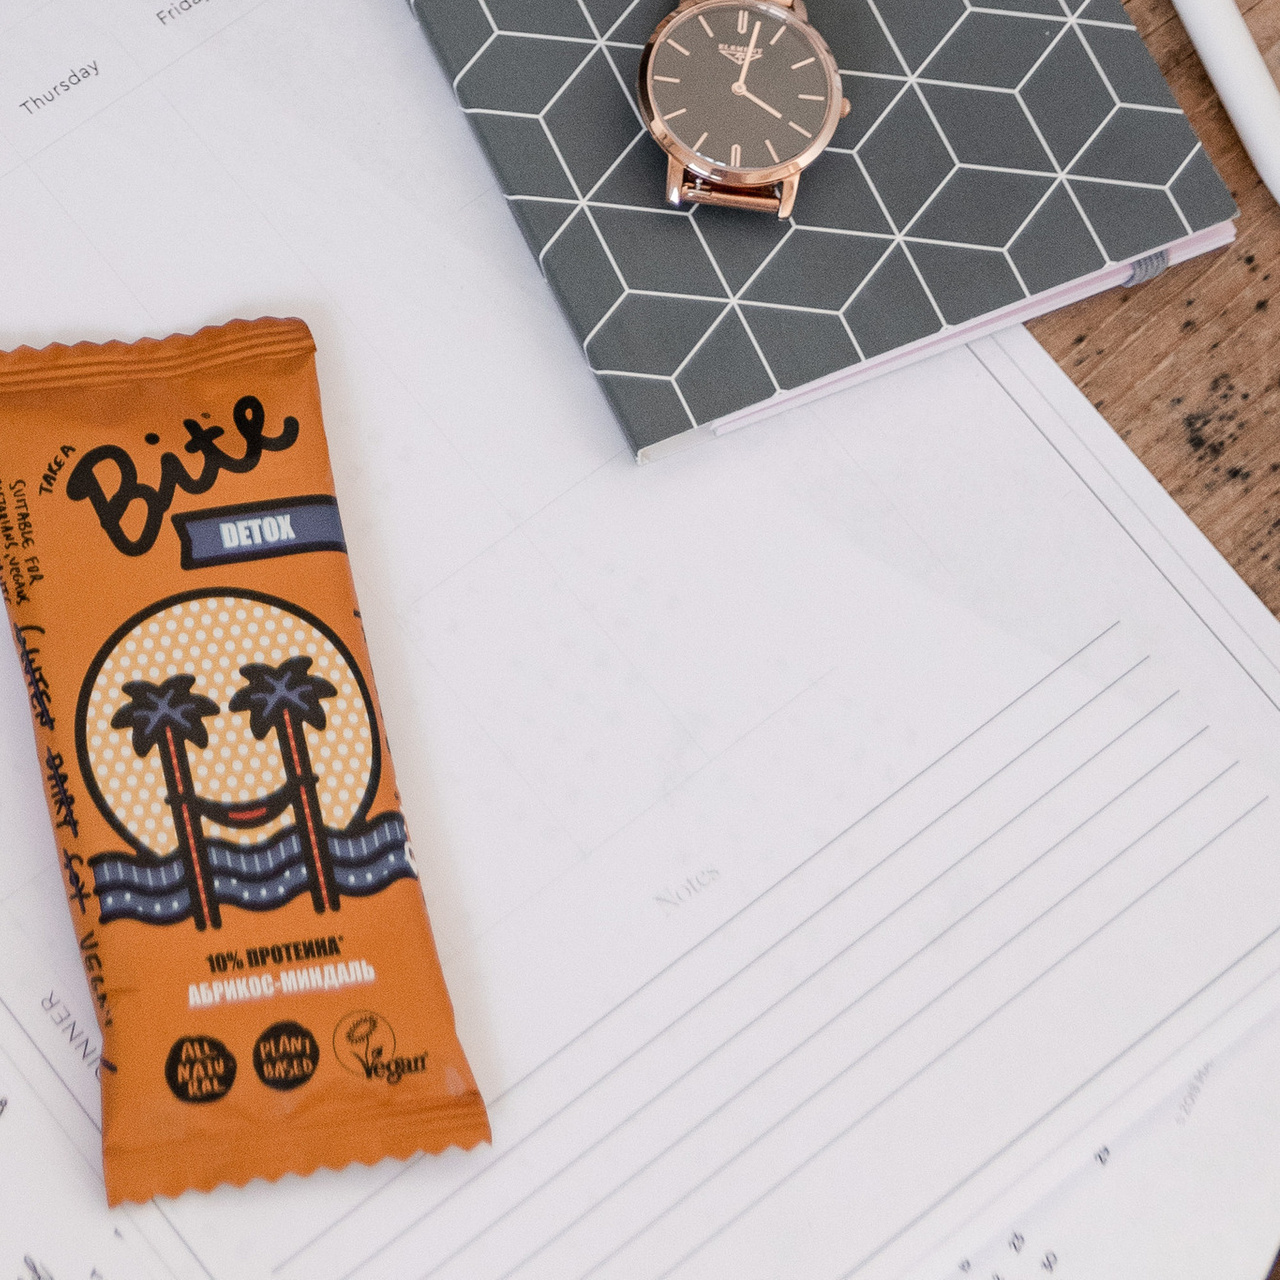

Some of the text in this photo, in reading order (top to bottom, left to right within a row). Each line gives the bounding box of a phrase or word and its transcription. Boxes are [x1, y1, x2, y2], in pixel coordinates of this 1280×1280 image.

[20, 57, 101, 116] Thursday
[38, 445, 76, 496] TAKE A
[66, 395, 300, 557] Bite
[9, 479, 44, 586] SUITABLE FOR
[220, 513, 296, 550] DETOX
[206, 951, 244, 975] 10%
[187, 959, 376, 1009] АБРИКОС-МИНДАЛЬ
[181, 1040, 216, 1060] ALL
[260, 1034, 313, 1060] PLANT
[263, 1057, 314, 1080] BASED
[360, 1048, 429, 1085] Vegan
